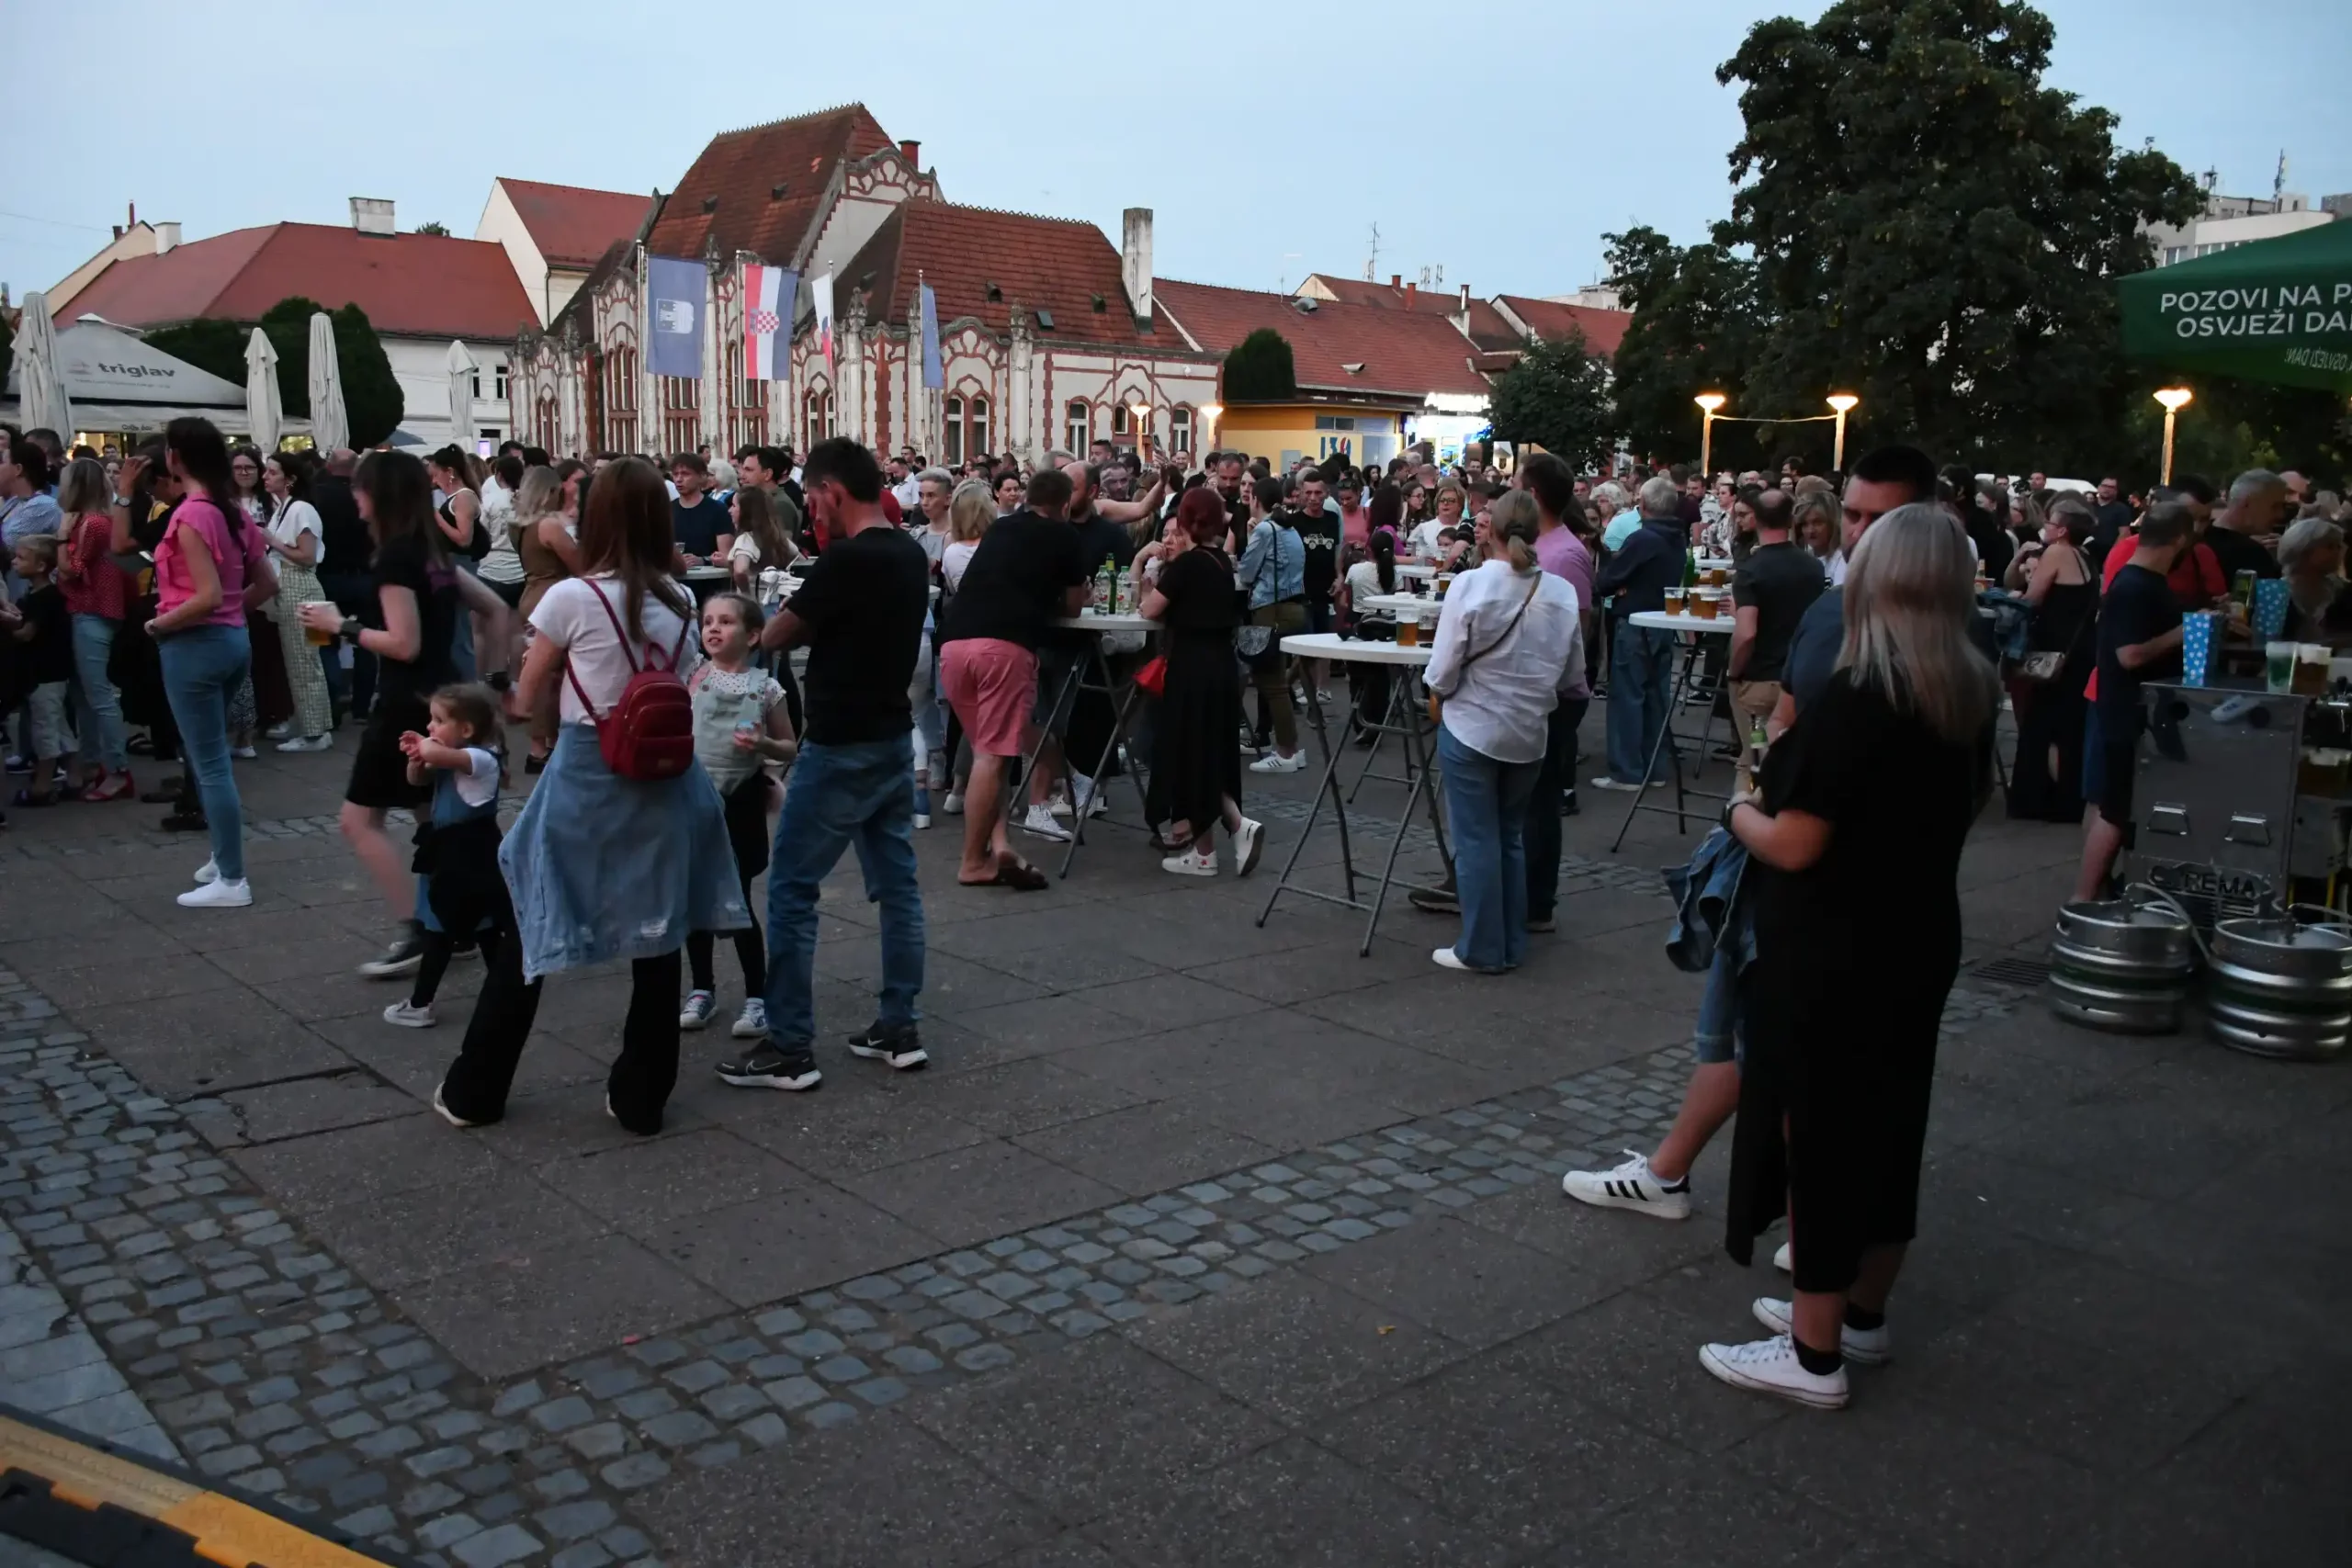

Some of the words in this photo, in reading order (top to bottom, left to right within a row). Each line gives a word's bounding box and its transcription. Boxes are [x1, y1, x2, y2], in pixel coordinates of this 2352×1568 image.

[2160, 288, 2268, 313] POZOVI
[2278, 285, 2322, 307] NA
[2334, 283, 2352, 305] P
[2176, 308, 2294, 338] OSVJEŽI
[2304, 310, 2352, 333] DA
[97, 362, 176, 378] triglav
